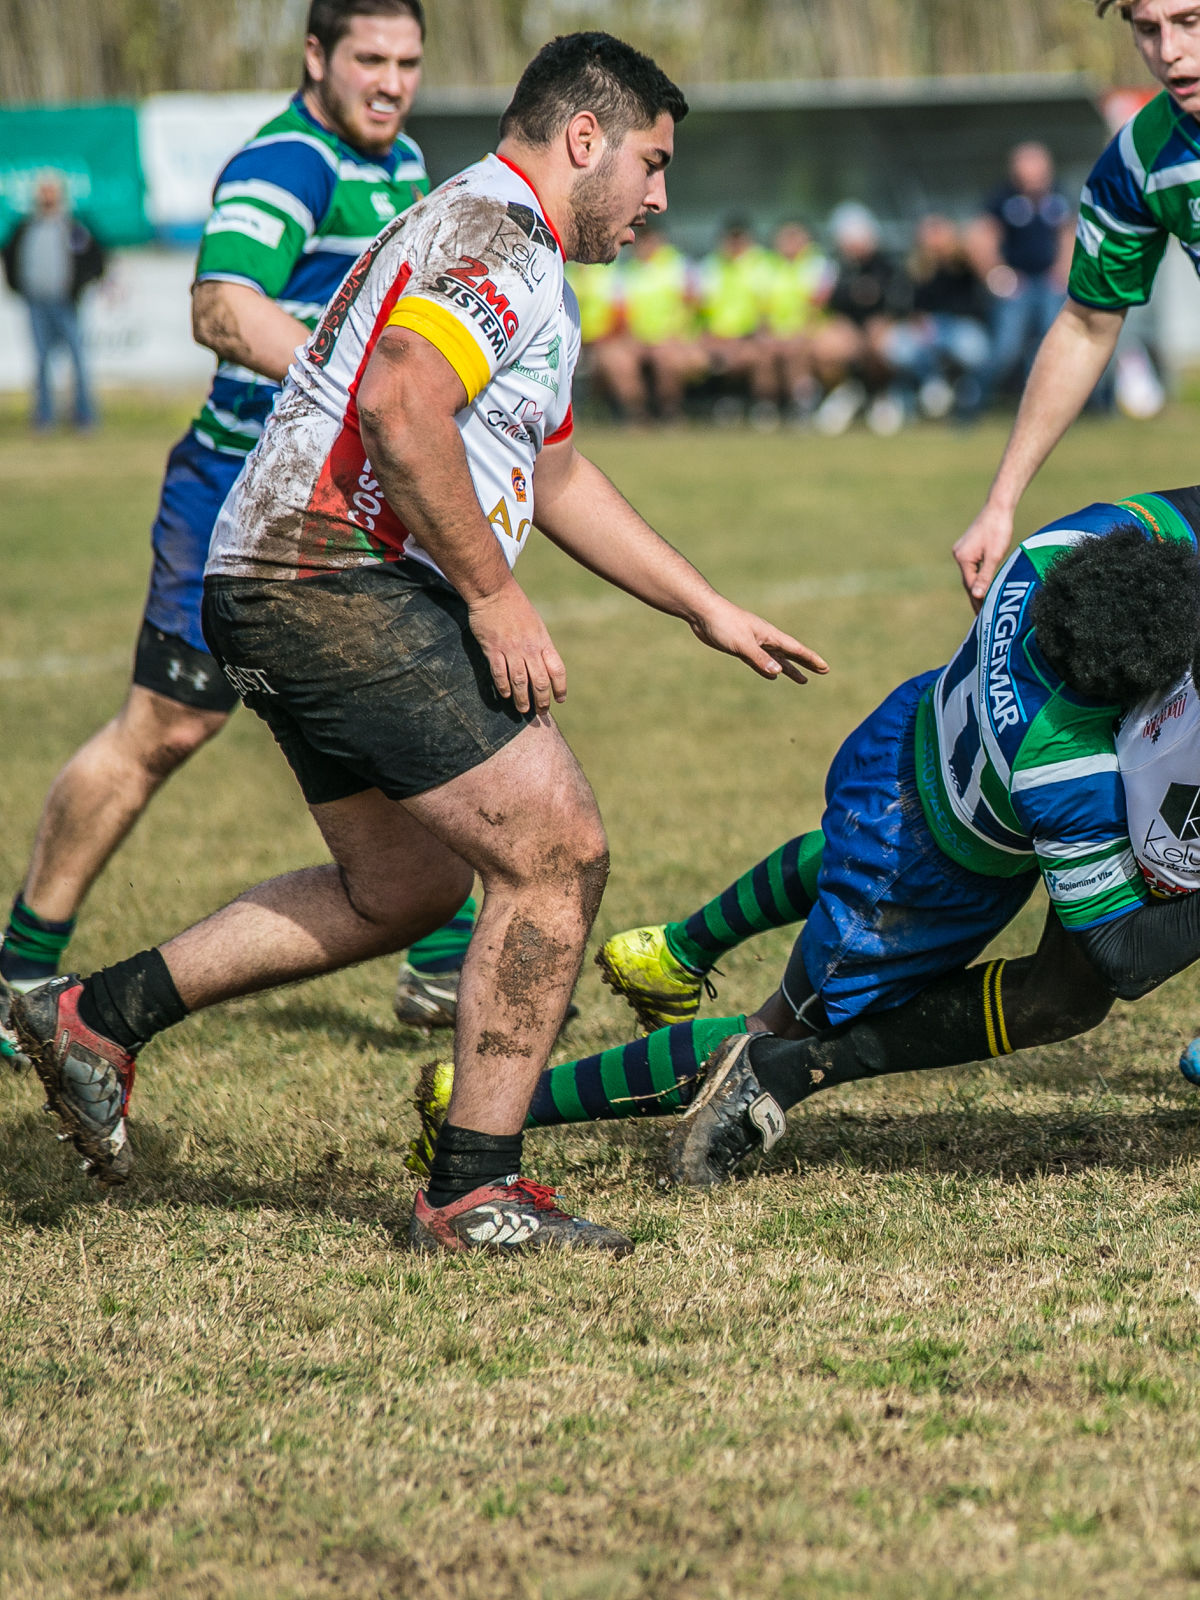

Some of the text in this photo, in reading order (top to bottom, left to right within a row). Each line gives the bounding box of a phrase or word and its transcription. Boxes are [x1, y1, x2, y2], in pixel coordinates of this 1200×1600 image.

[427, 276, 507, 362] SISTEMI
[444, 254, 520, 341] 2MG
[989, 581, 1031, 735] INGEMAR
[1096, 870, 1113, 882] Vita
